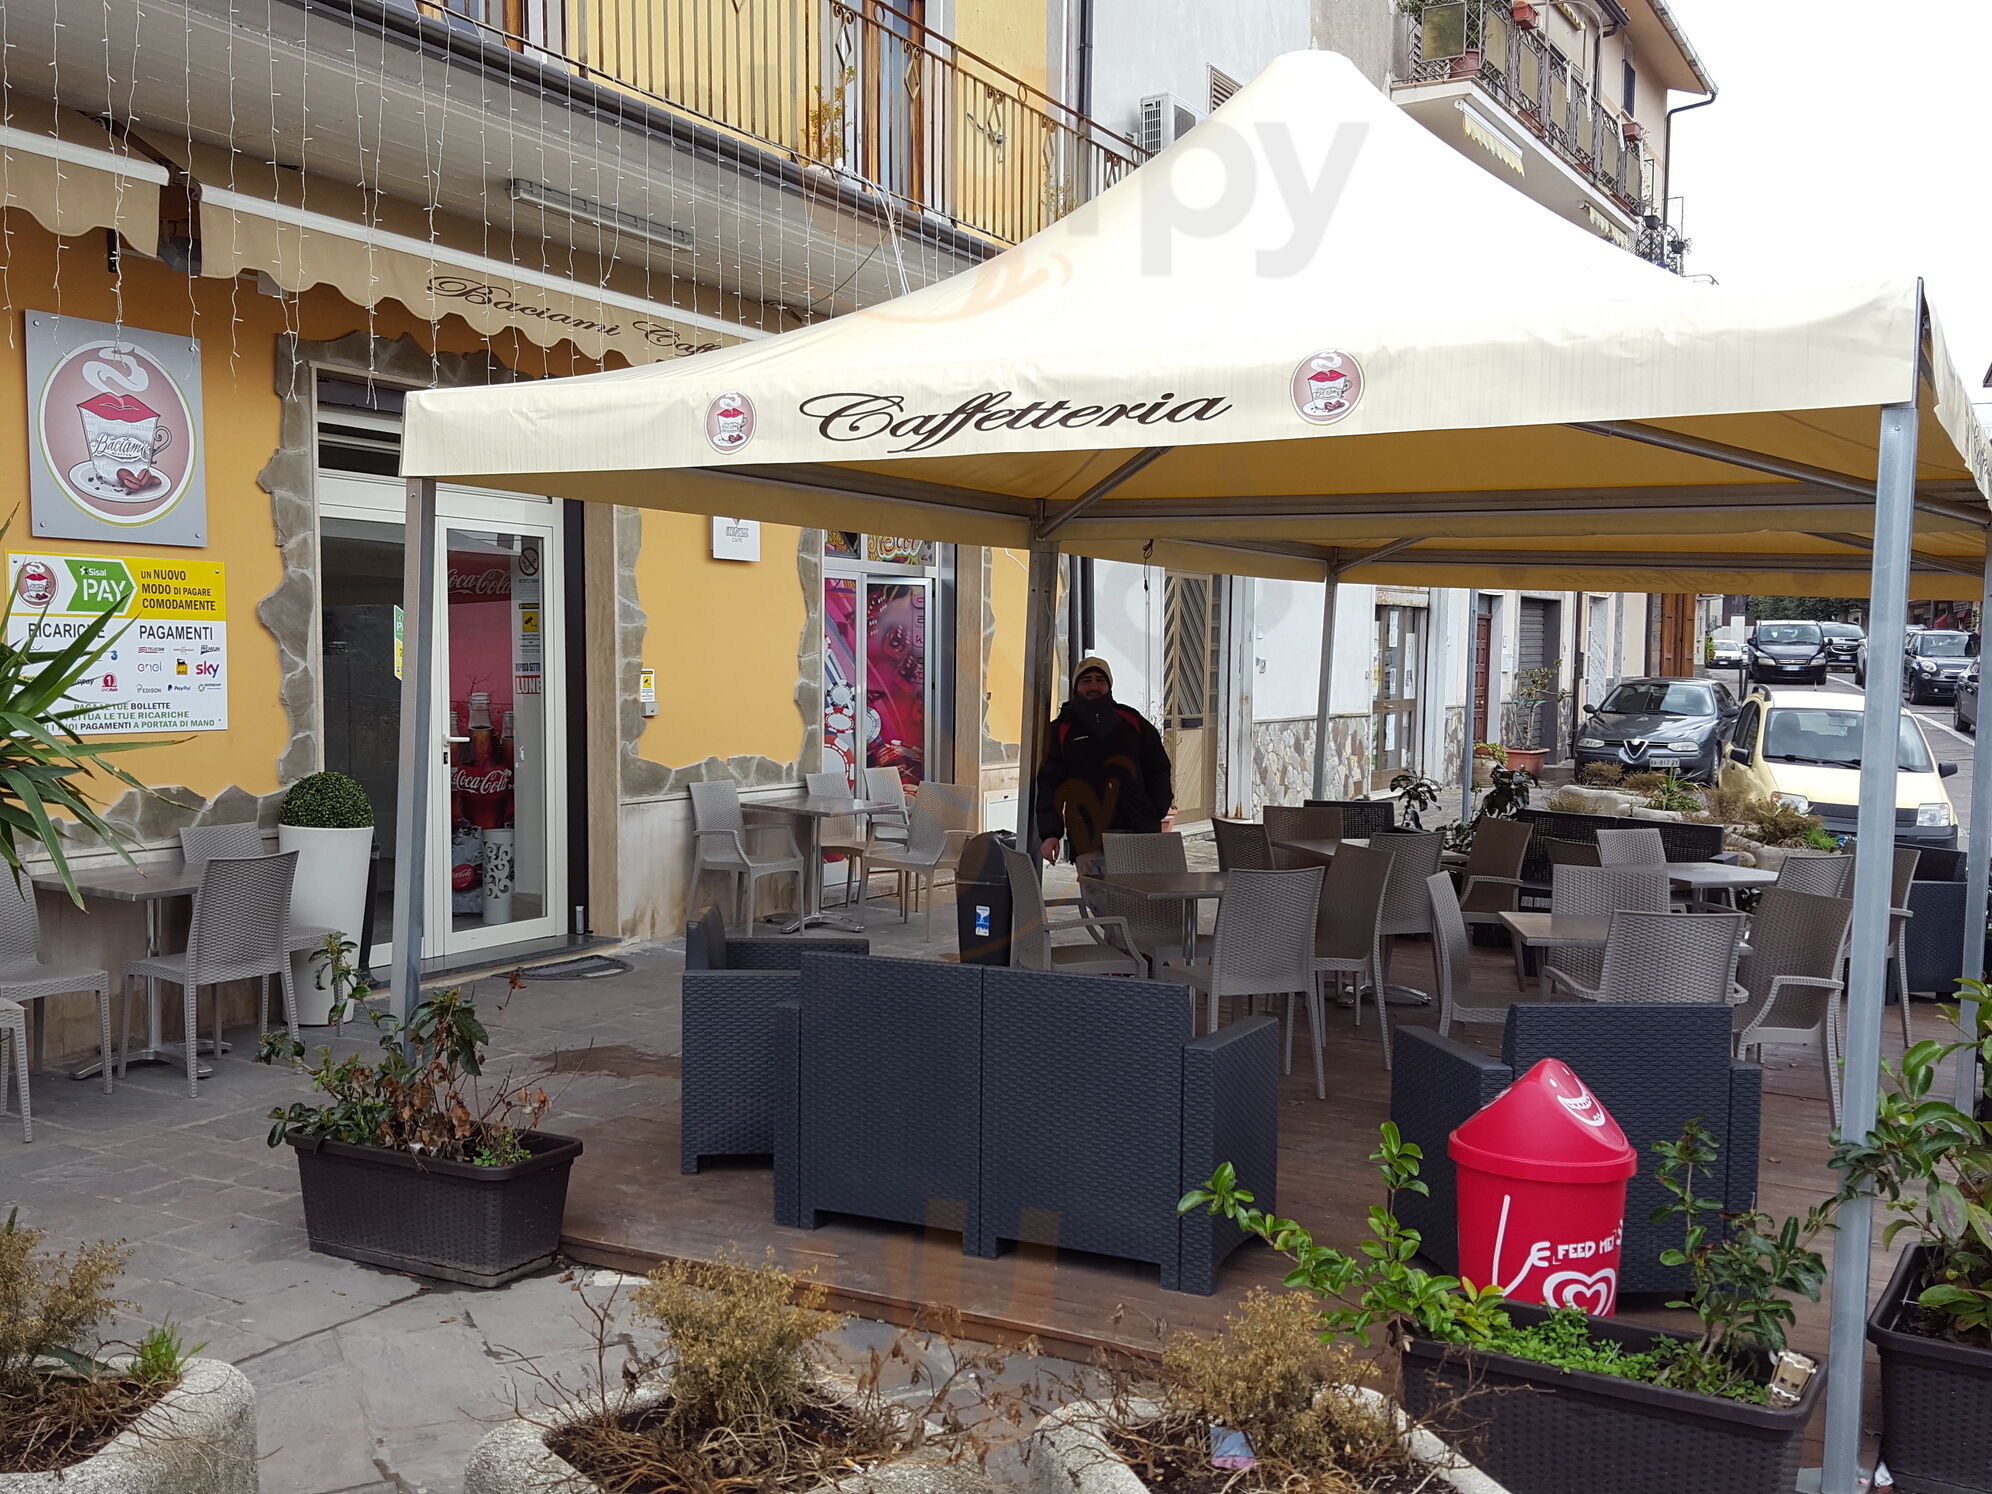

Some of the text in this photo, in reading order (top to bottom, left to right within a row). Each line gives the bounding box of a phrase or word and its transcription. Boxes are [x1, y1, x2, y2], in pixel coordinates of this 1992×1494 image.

[428, 275, 621, 338] Baciami
[799, 390, 1233, 453] Caffetteria
[88, 567, 107, 577] Sisal
[141, 569, 187, 581] UN NUOVO
[82, 578, 126, 602] PAY
[141, 583, 212, 597] MODO DI PAGARE
[142, 598, 216, 611] COMODAMENTE
[139, 625, 213, 641] PAGAMENTI
[110, 650, 118, 661] 3
[195, 660, 220, 679] sky
[130, 702, 171, 710] BOLLETTE
[104, 712, 115, 720] LE
[117, 712, 136, 720] TUE
[137, 711, 190, 720] RICARICHE
[80, 721, 132, 730] PAGAMENTI
[133, 721, 140, 729] A
[141, 720, 178, 729] PORTATA
[179, 720, 189, 728] DI
[190, 719, 215, 727] MANO
[1557, 1241, 1597, 1260] FEED
